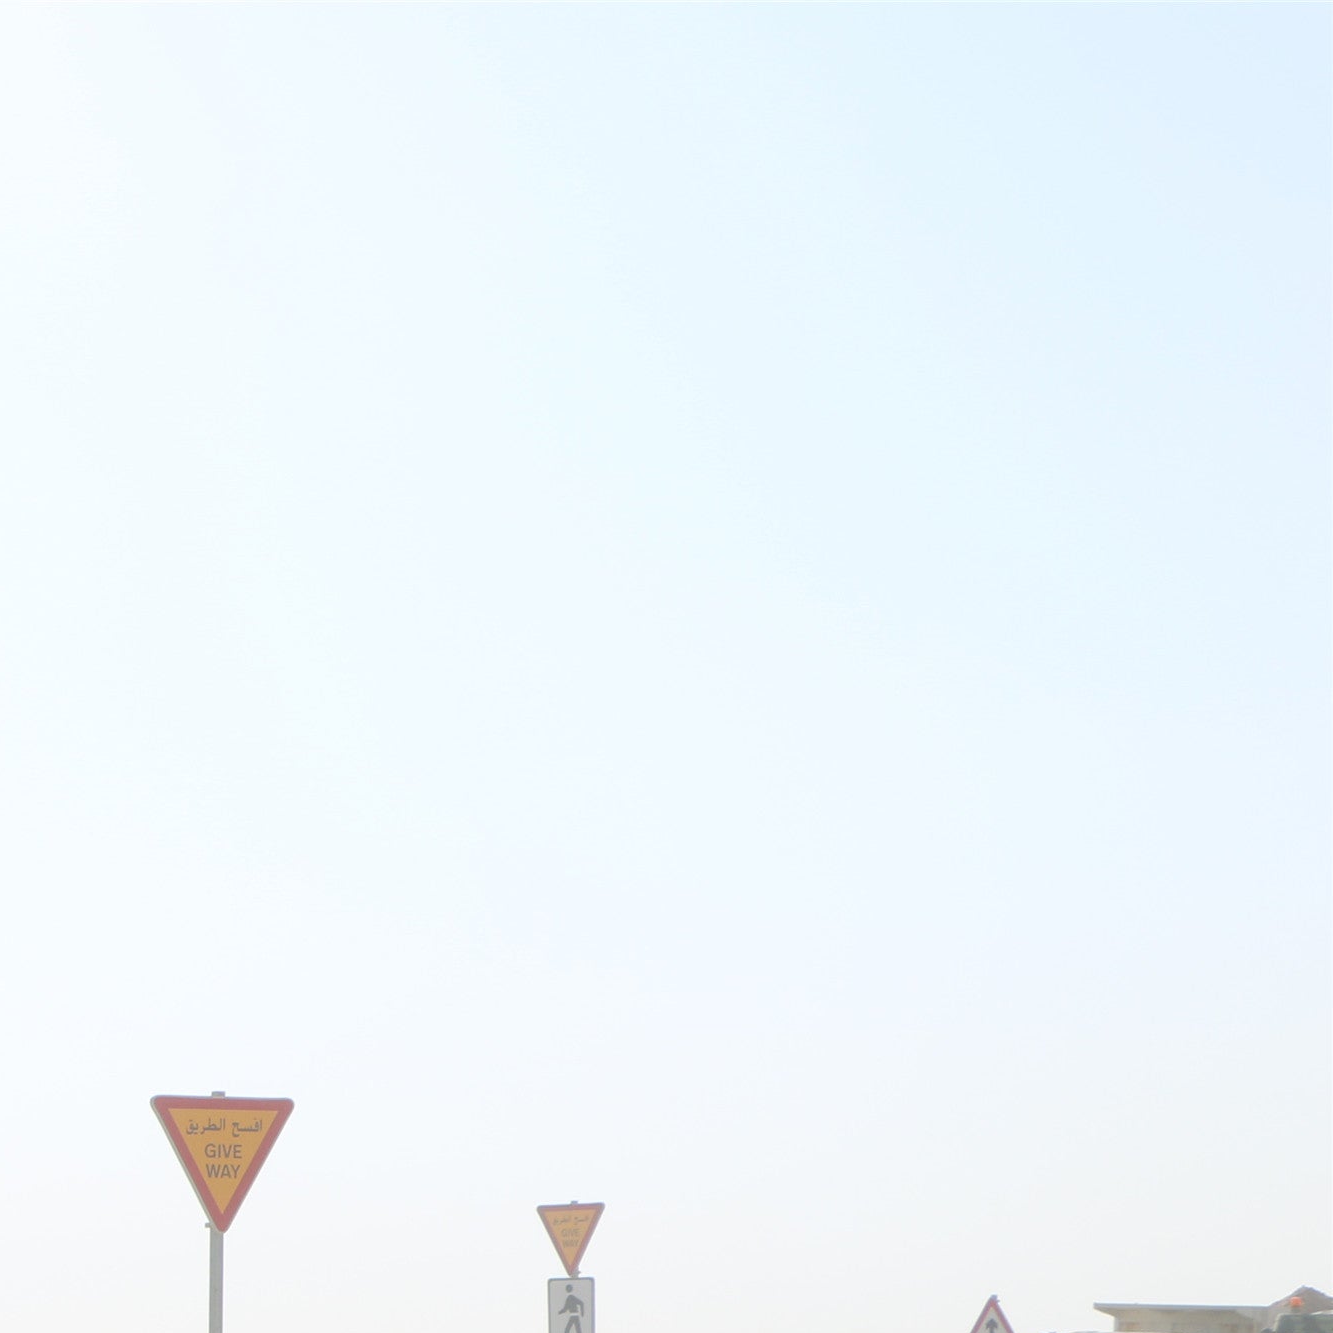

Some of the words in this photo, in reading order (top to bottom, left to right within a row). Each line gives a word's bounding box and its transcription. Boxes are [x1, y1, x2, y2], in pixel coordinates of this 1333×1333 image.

[186, 1117, 226, 1135] الطريق
[231, 1117, 263, 1137] افسح
[204, 1143, 243, 1159] GIVE
[205, 1163, 241, 1179] WAY
